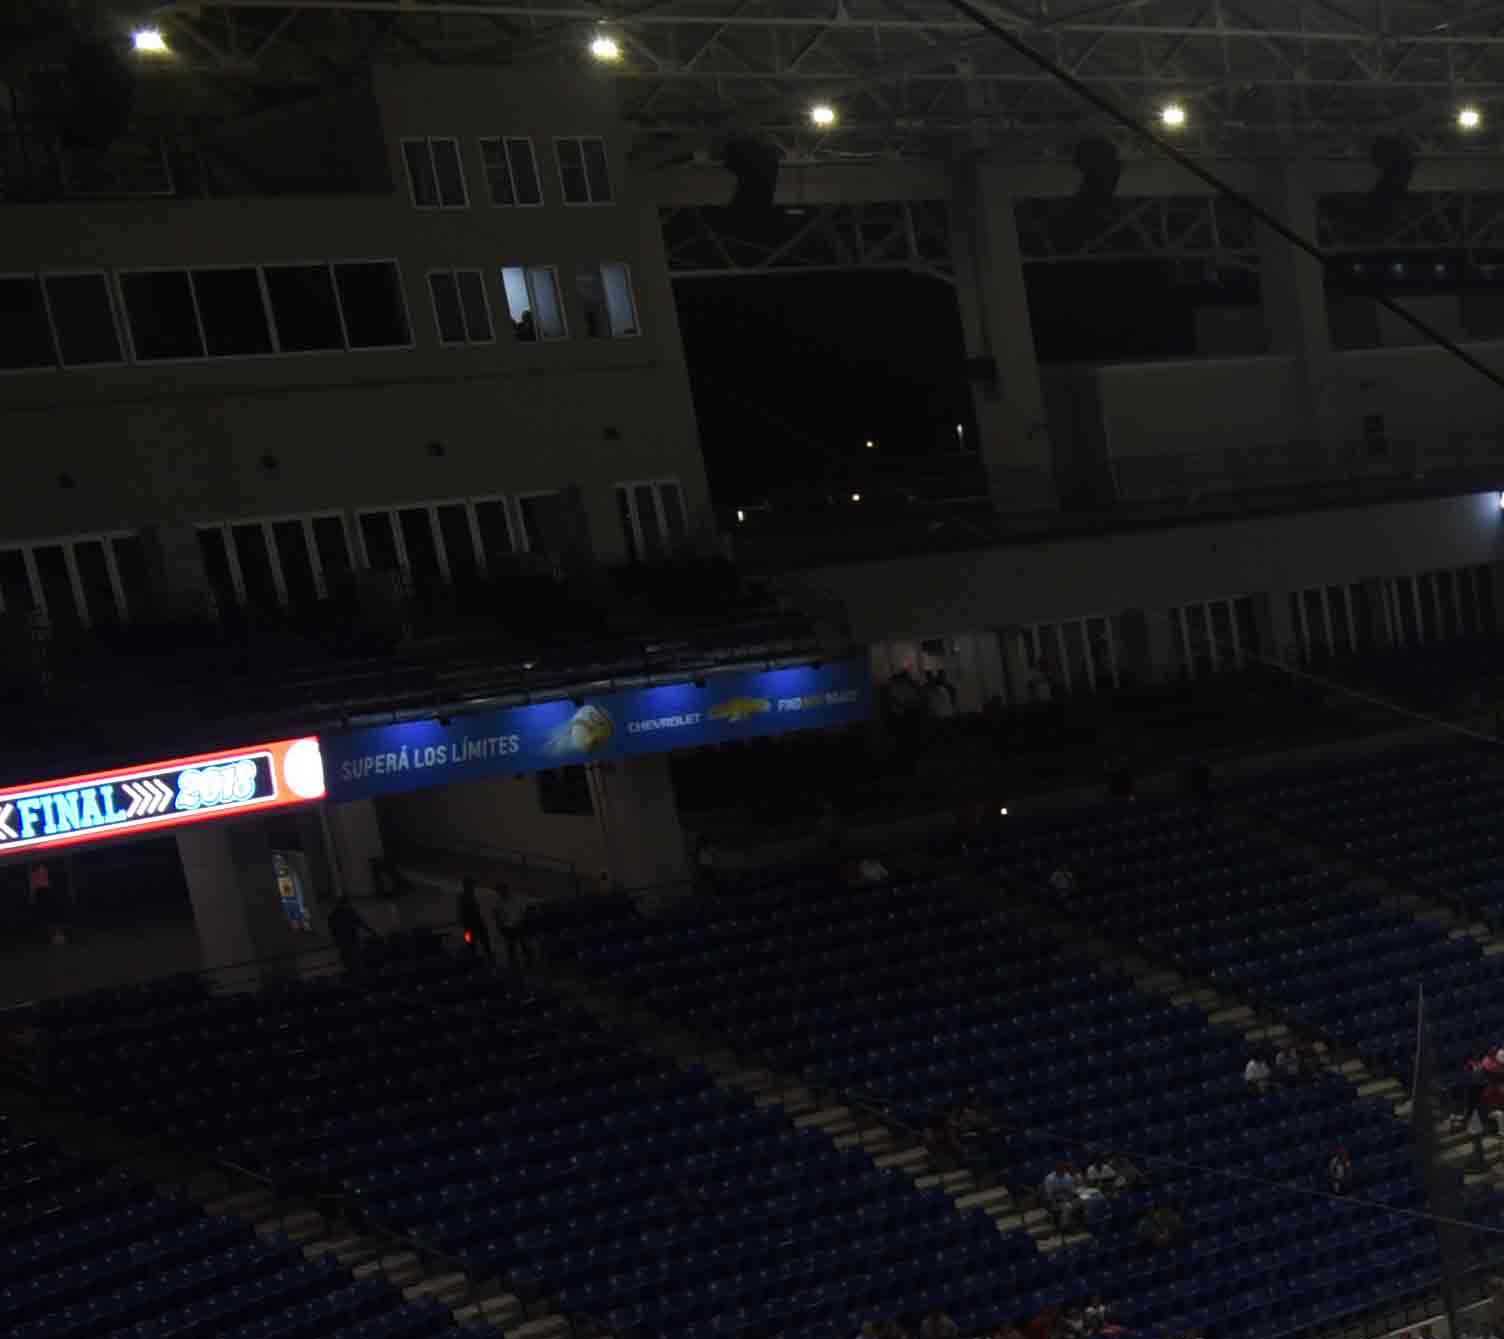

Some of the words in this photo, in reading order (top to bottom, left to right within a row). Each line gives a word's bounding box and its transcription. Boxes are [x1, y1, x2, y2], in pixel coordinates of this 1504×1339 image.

[626, 711, 702, 735] CHEVROLET
[341, 742, 414, 782] SUPERÁ
[413, 742, 447, 770] LOS
[451, 733, 521, 764] LÍMITES
[17, 785, 129, 838] FINAL
[175, 758, 258, 810] 2018
